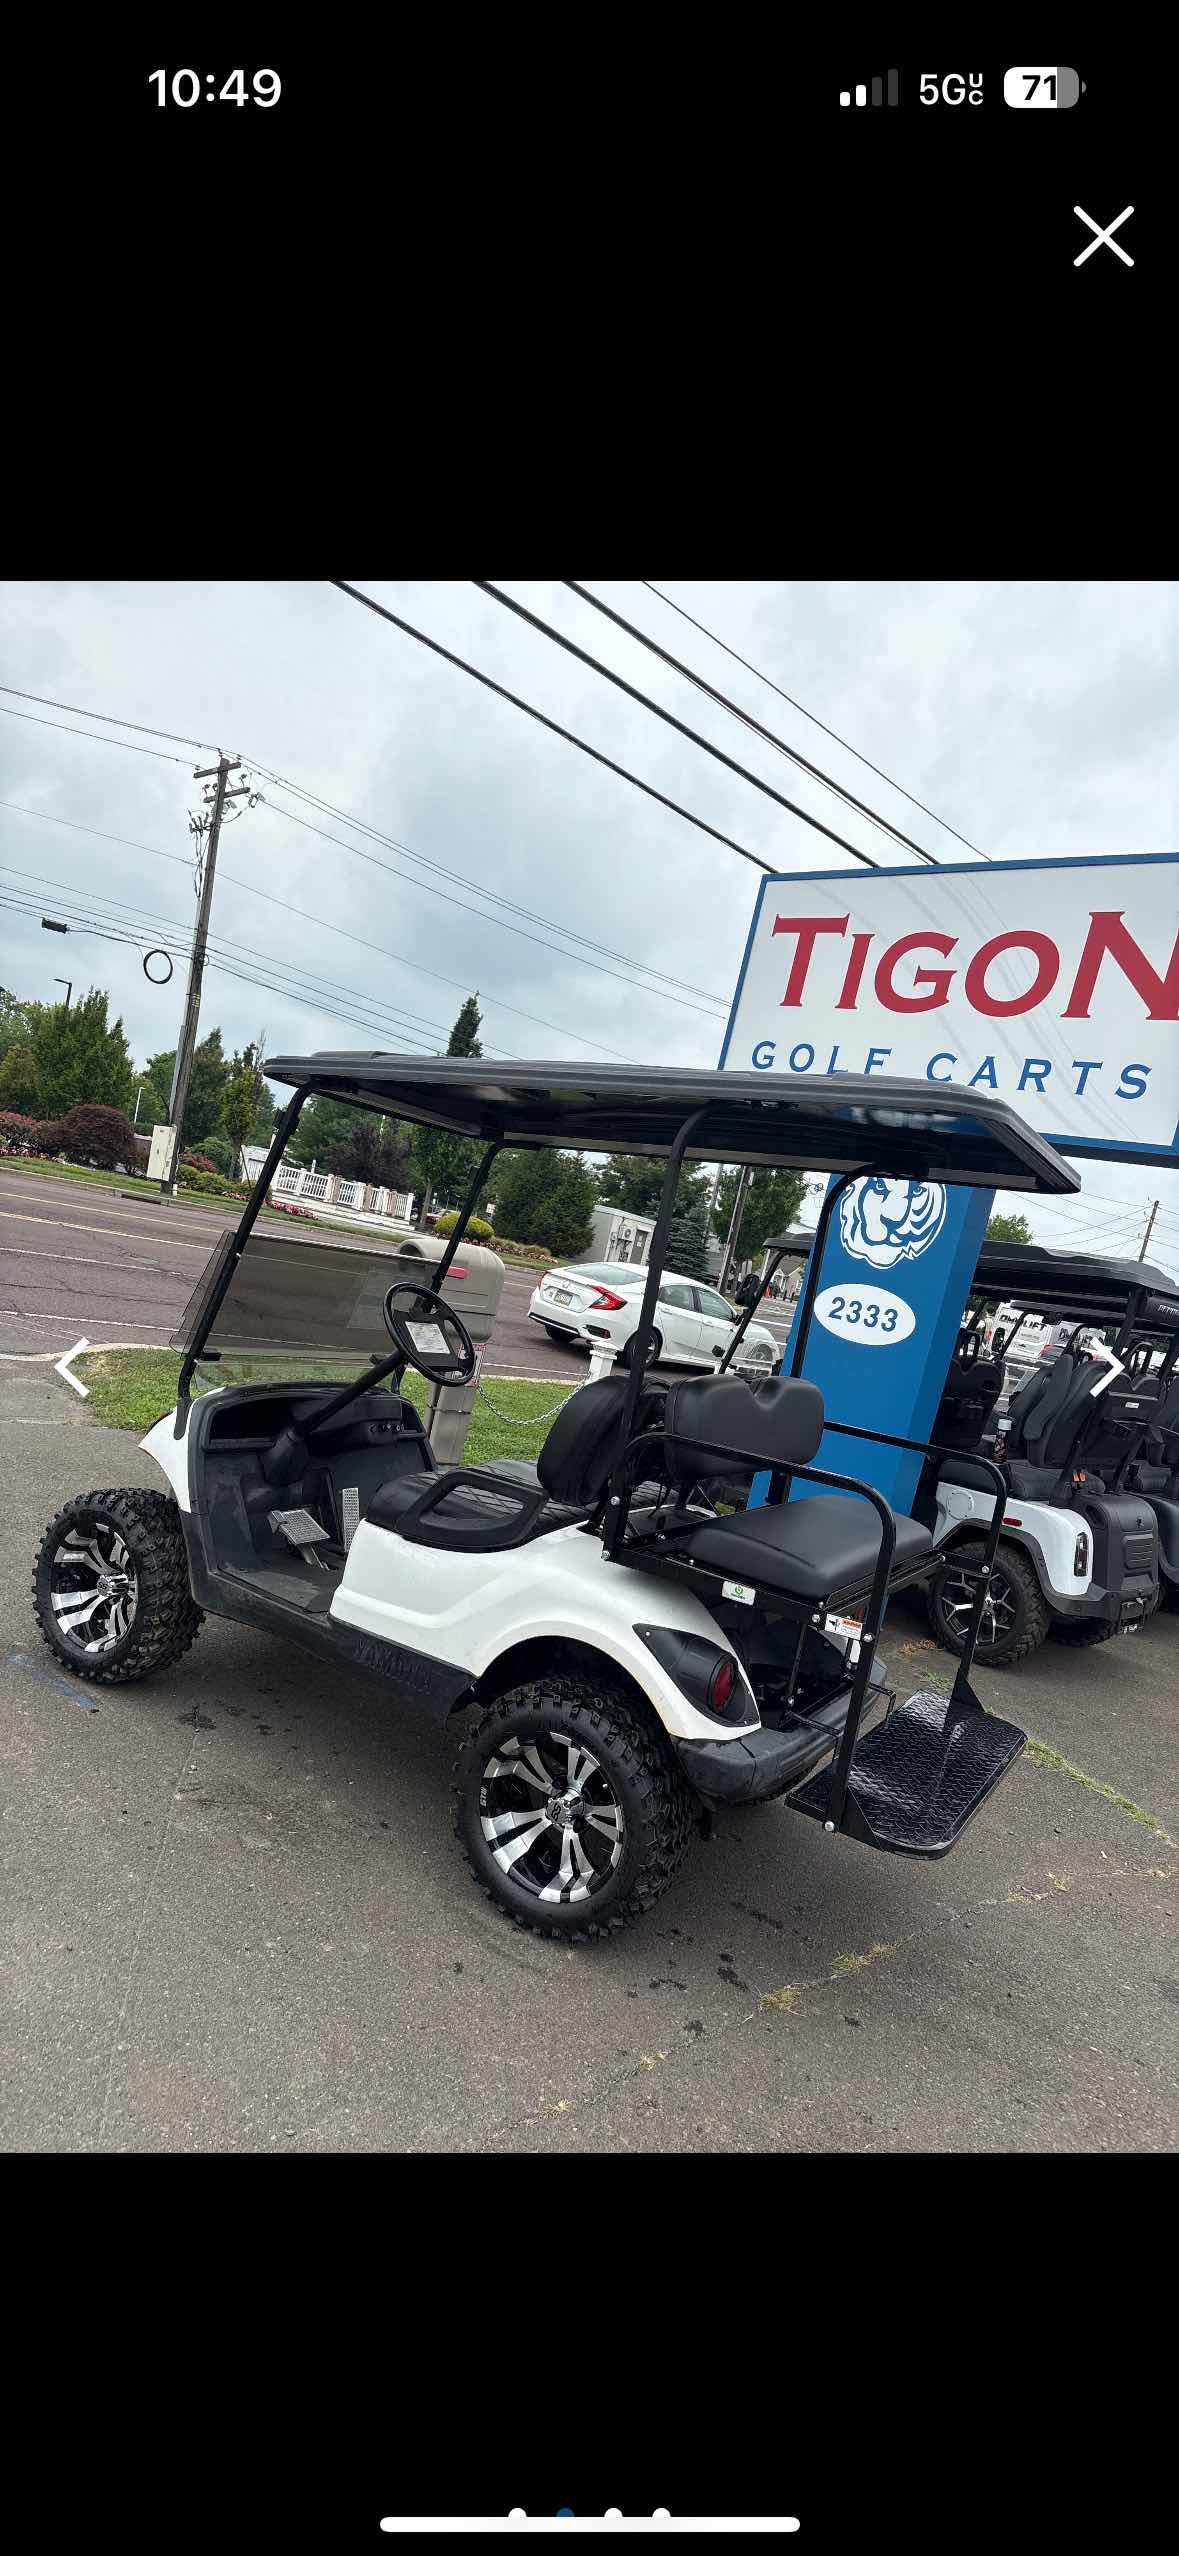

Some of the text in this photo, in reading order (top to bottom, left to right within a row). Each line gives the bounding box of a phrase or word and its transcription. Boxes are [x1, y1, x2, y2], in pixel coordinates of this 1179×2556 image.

[772, 912, 1179, 1020] TIGON
[752, 1041, 1151, 1099] GOLF CARTS
[828, 1296, 898, 1332] 2333
